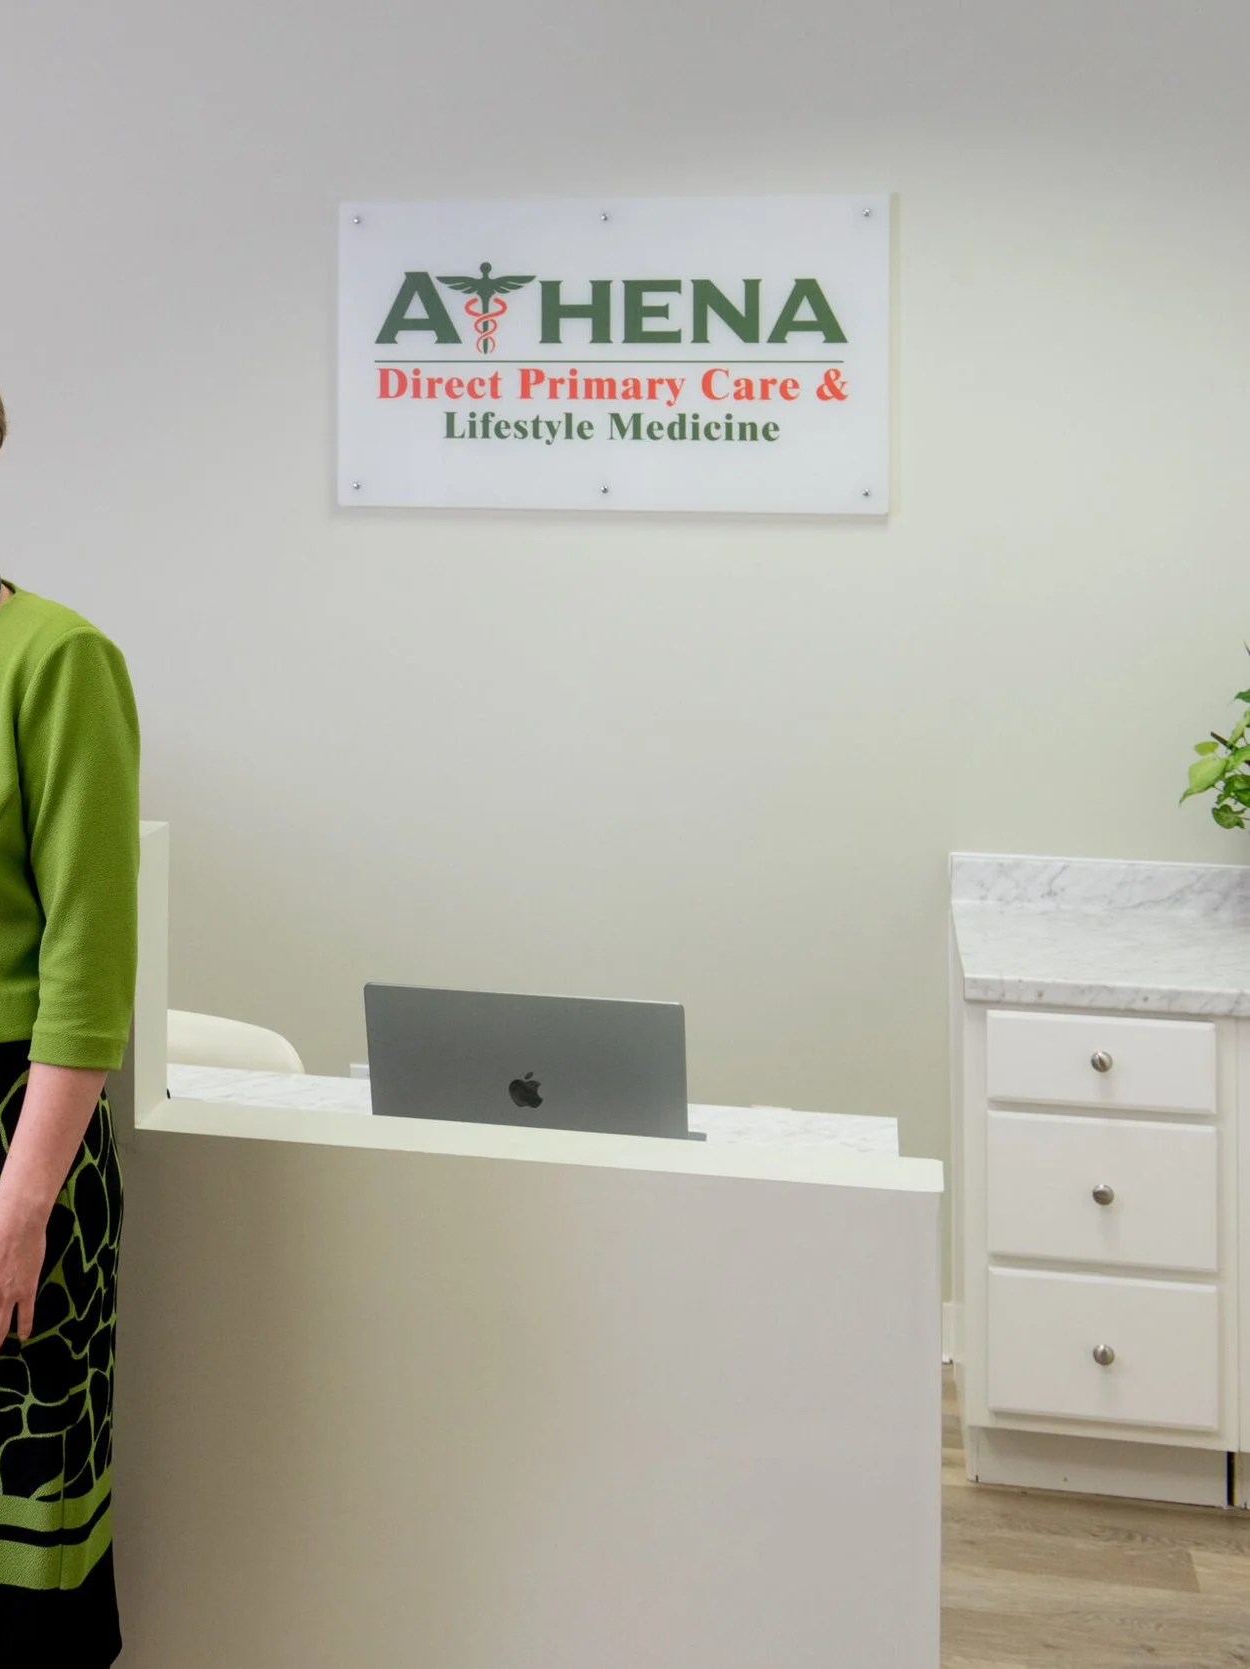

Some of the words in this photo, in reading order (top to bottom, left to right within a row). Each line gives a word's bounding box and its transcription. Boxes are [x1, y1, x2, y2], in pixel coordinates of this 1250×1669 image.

[374, 261, 849, 355] ATHENA
[376, 367, 502, 401] Direct
[517, 367, 686, 408] Primary
[700, 367, 801, 402] Care
[815, 368, 849, 402] &
[443, 411, 595, 446] Lifestyle
[608, 412, 781, 442] Medicine
